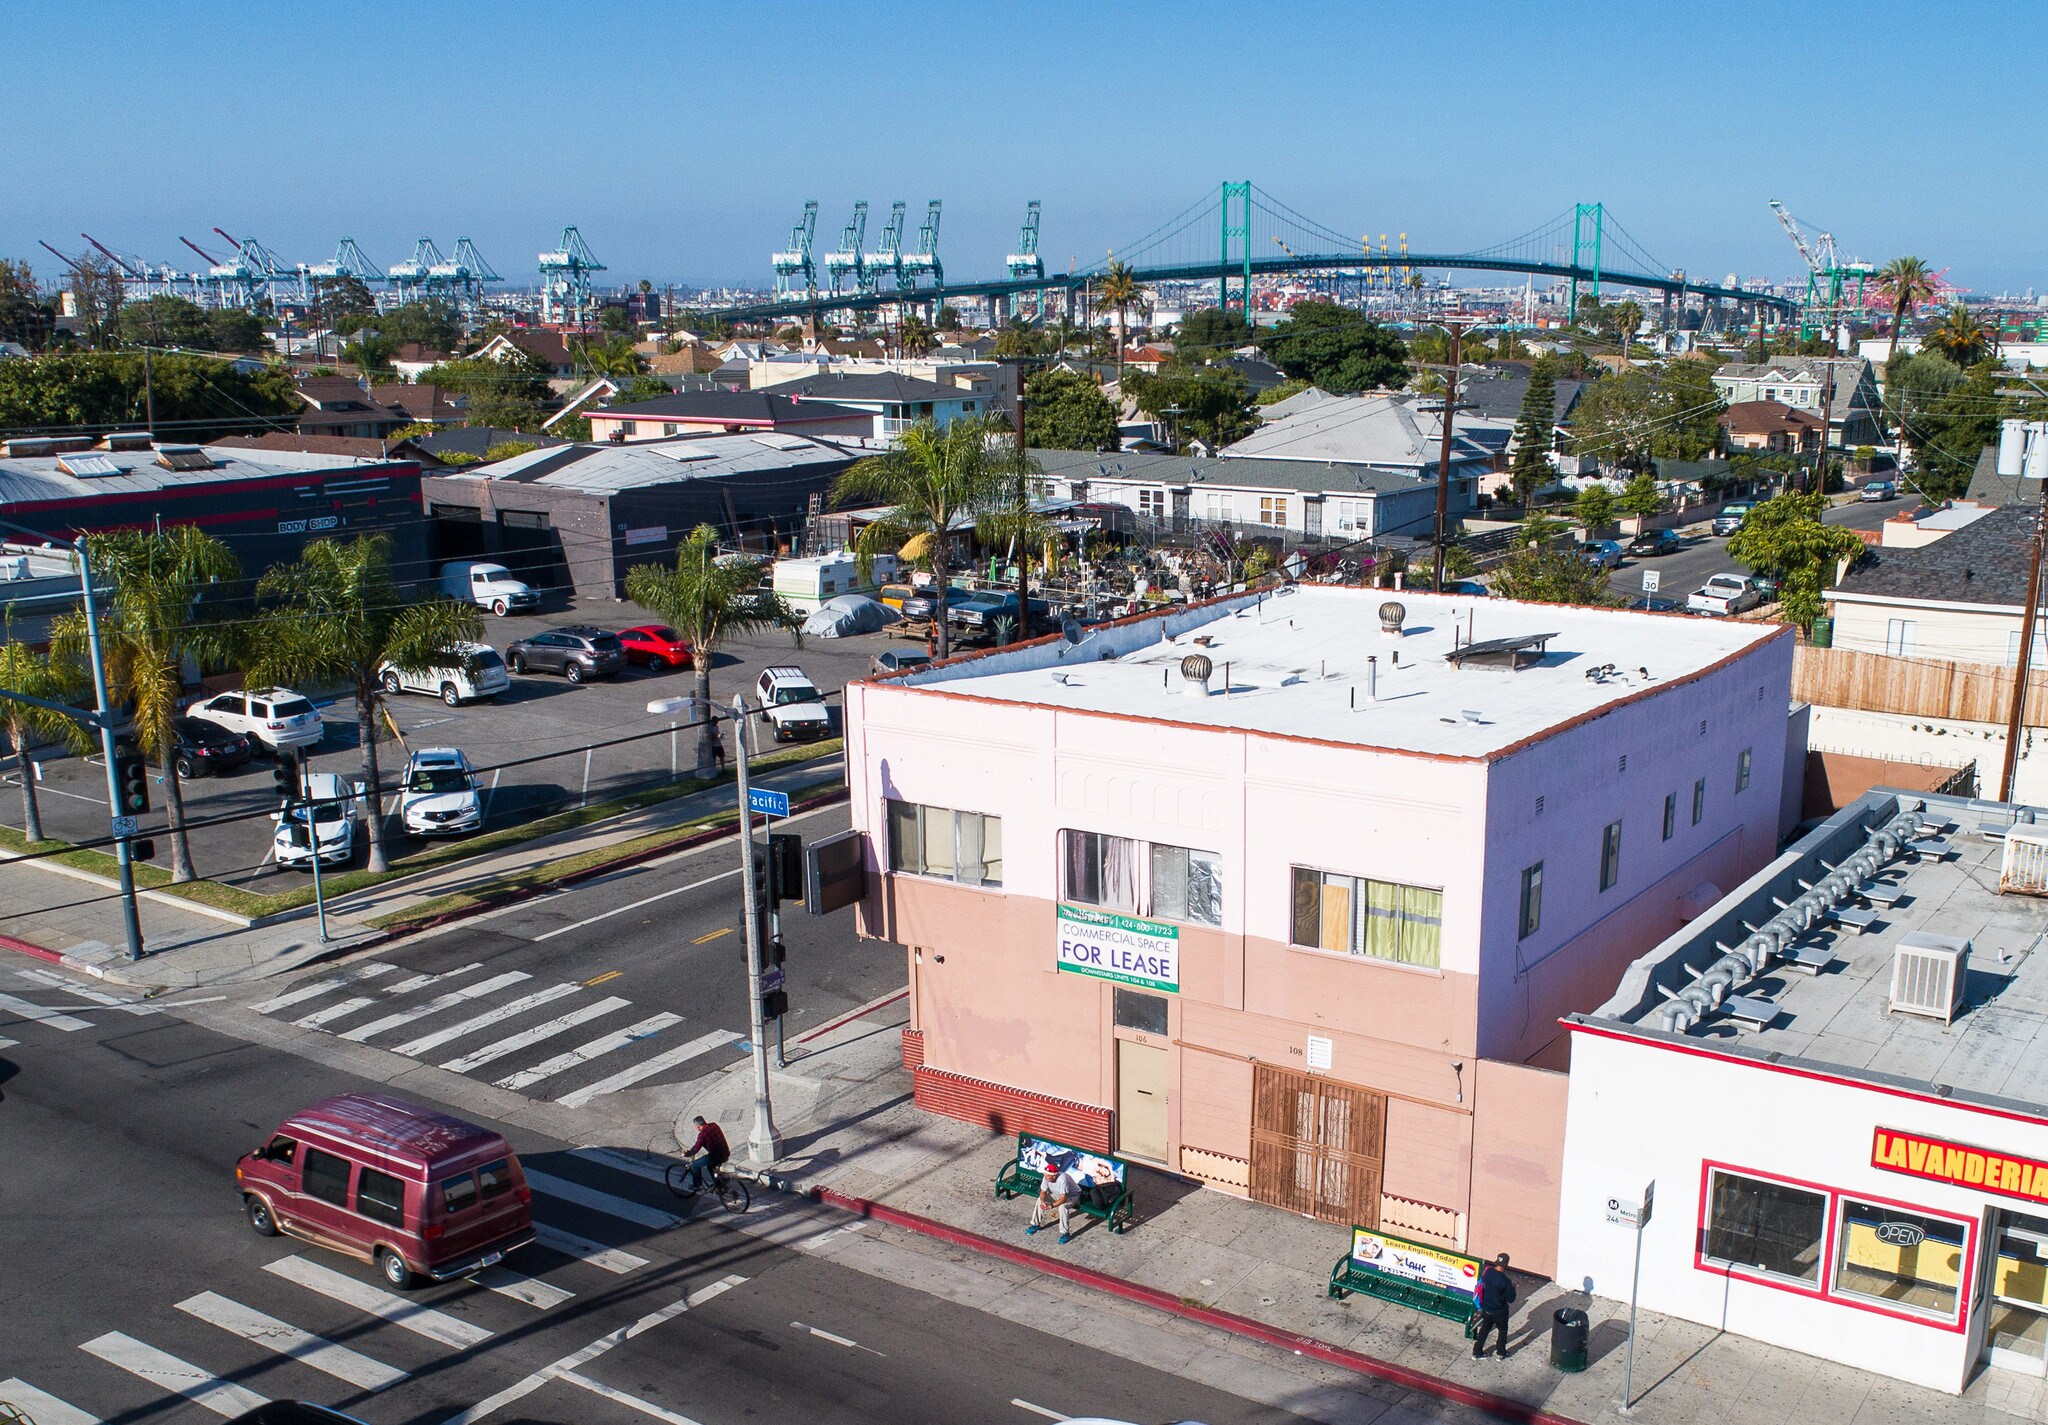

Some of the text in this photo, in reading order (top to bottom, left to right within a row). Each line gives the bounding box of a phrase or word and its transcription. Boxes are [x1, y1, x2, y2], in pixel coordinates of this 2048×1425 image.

[279, 516, 337, 533] BODY SHOP
[1645, 581, 1656, 590] 30
[750, 794, 784, 810] acific
[1063, 923, 1170, 953] COMMERCIAL SPACE
[1062, 940, 1170, 978] FOR LEASE
[1081, 967, 1114, 980] DOWNSTAIRS
[1114, 973, 1129, 982] UNITS
[1136, 1034, 1147, 1043] 106
[1290, 1046, 1303, 1056] 108
[1607, 1215, 1619, 1223] 246
[1620, 1210, 1637, 1219] Metro
[1878, 1225, 1921, 1246] OPEN
[1385, 1239, 1459, 1265] Learn English Today!
[1405, 1257, 1427, 1274] LAHC
